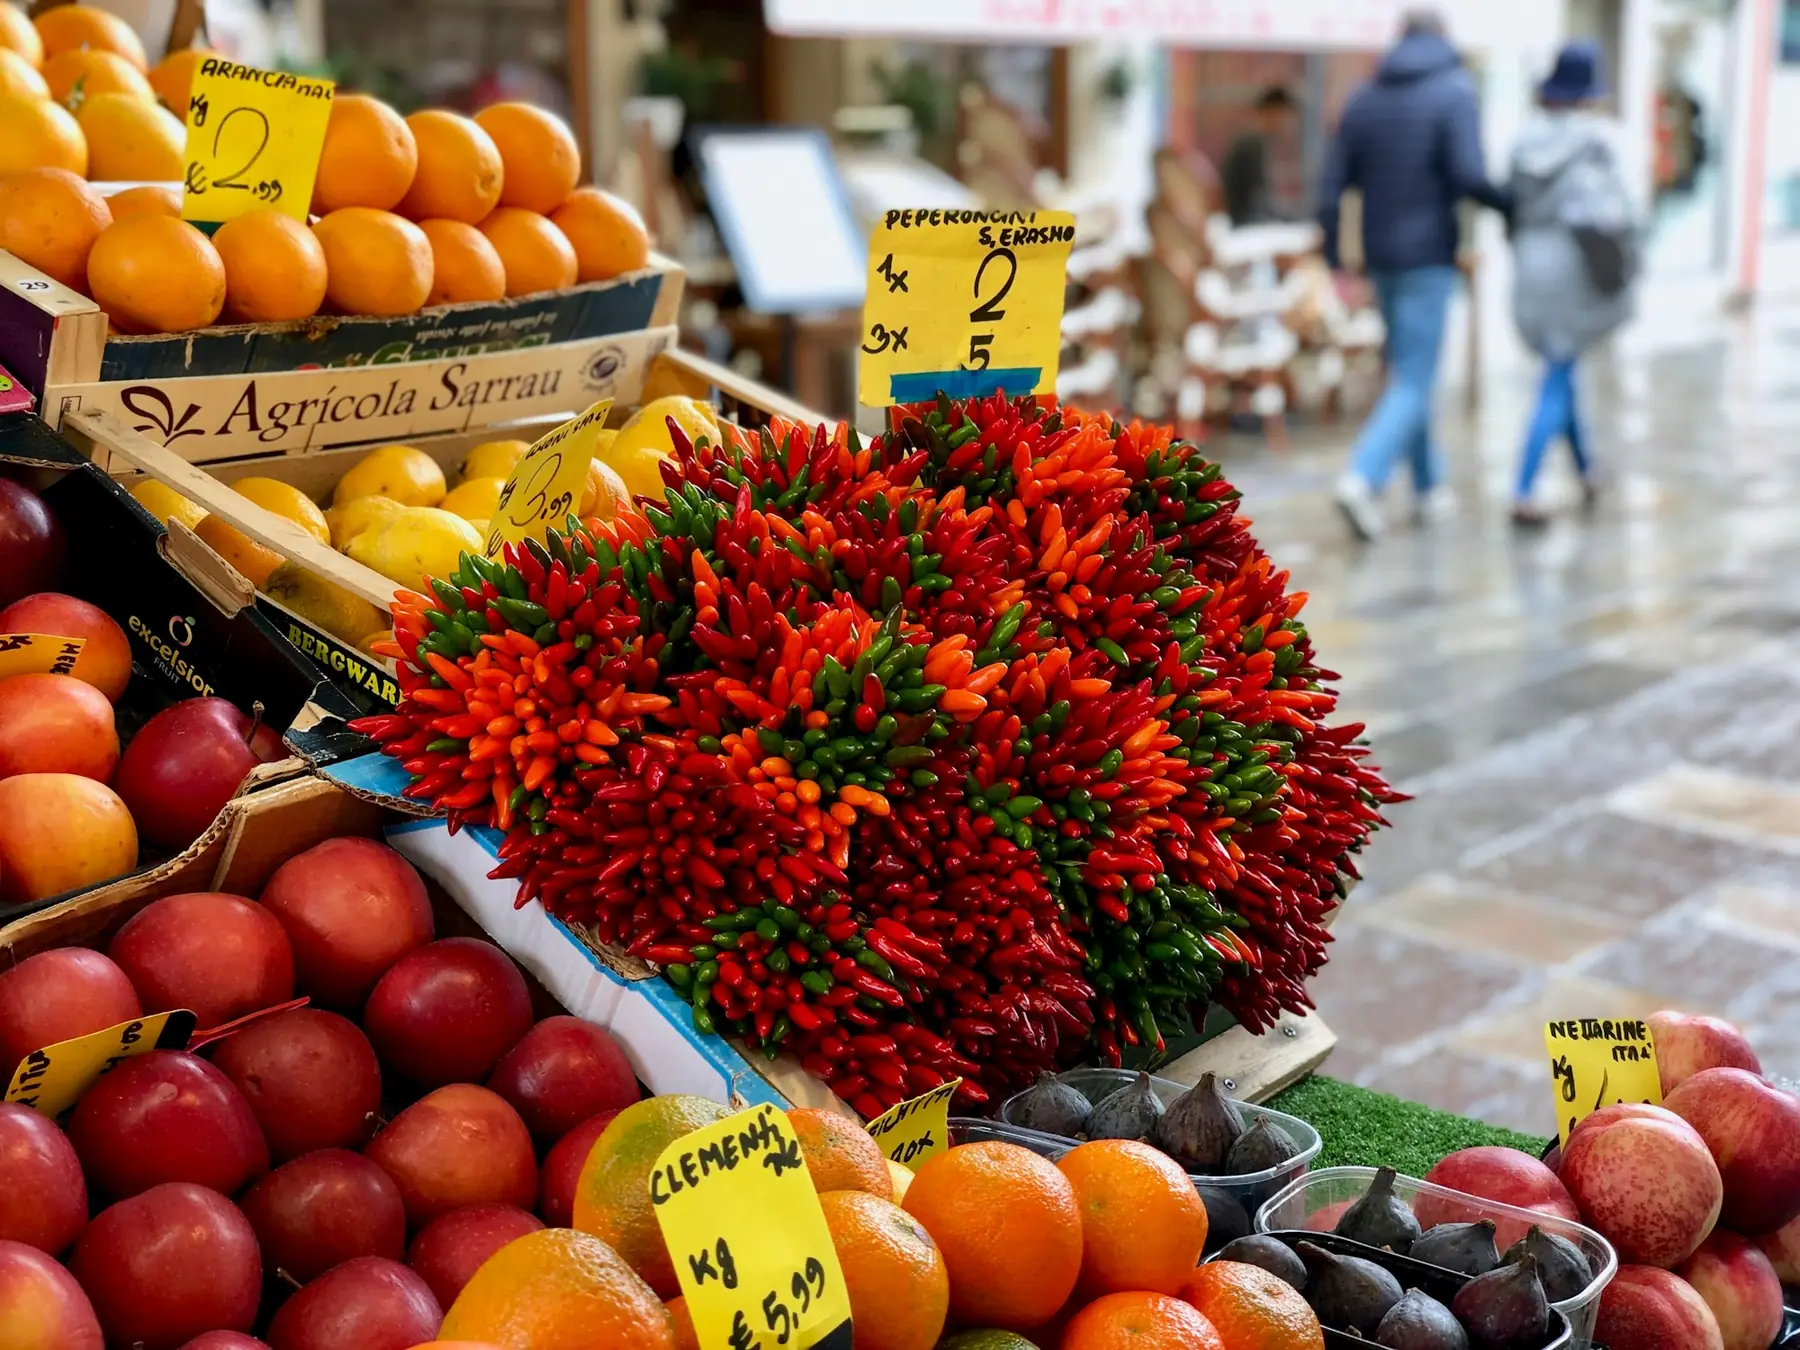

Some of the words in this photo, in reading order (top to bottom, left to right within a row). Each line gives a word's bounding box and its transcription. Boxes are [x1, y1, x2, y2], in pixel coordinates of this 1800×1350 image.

[201, 58, 297, 90] ARANCIA
[20, 280, 50, 291] 29
[969, 247, 1018, 323] 2
[961, 334, 995, 372] 5
[215, 378, 415, 442] Agrícola
[429, 362, 562, 411] Sarrau
[128, 615, 215, 697] excelsior
[153, 657, 181, 685] FRUIT
[288, 623, 406, 706] BERGWAR
[1549, 1018, 1647, 1042] NETTARINE
